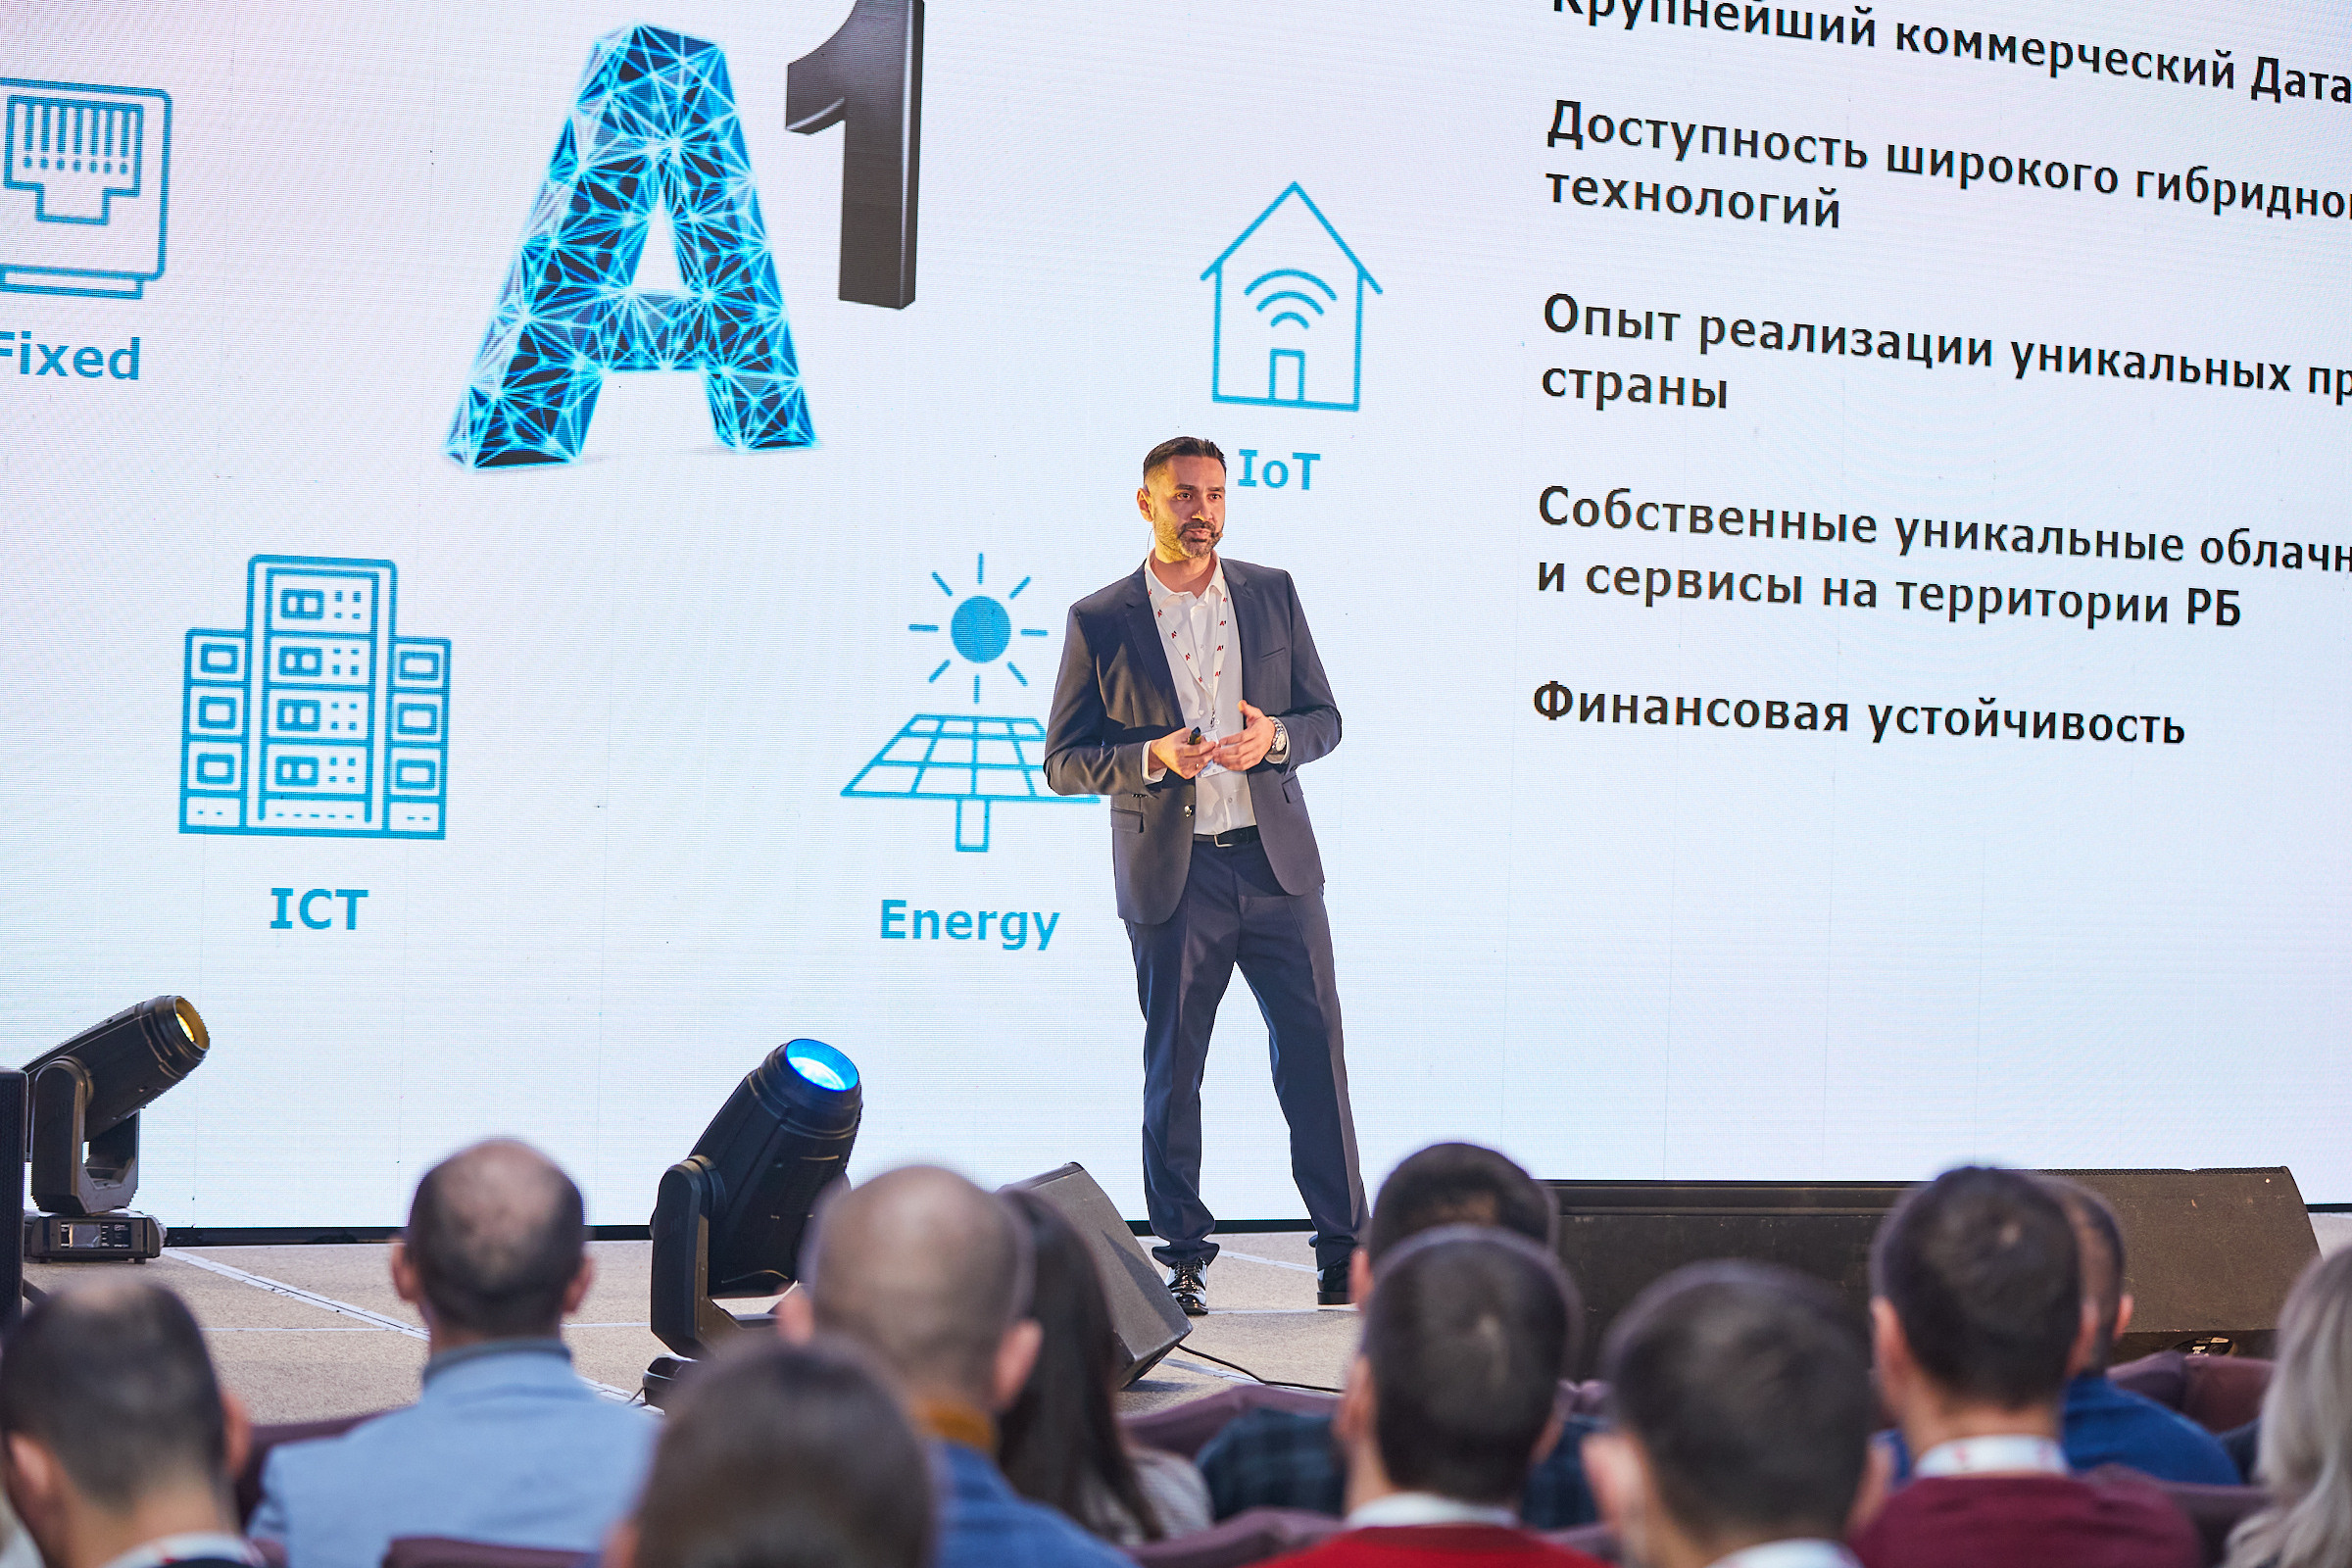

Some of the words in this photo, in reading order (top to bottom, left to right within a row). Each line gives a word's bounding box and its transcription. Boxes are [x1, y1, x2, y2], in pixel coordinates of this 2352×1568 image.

[1896, 24, 2234, 89] коммерческий
[2250, 56, 2352, 104] Дата
[1546, 99, 1868, 169] Доступность
[1887, 144, 2119, 194] широкого
[2136, 165, 2352, 220] гибридно
[1545, 172, 1839, 228] технологий
[1544, 293, 1681, 342] Опыт
[1700, 316, 1992, 369] реализации
[2010, 341, 2291, 392] уникальных
[1542, 368, 1727, 412] страны
[1238, 449, 1321, 490] IoT
[1539, 485, 1877, 544] Собственные
[1894, 517, 2183, 562] уникальные
[1539, 562, 1565, 592] и
[1587, 564, 1802, 608] сервисы
[1824, 577, 1877, 608] на
[1895, 581, 2168, 630] территории
[2187, 587, 2241, 627] РБ
[1534, 680, 1848, 732] Финансовая
[1868, 697, 2185, 744] устойчивость
[270, 887, 369, 931] ICT
[880, 899, 1061, 952] Energy
